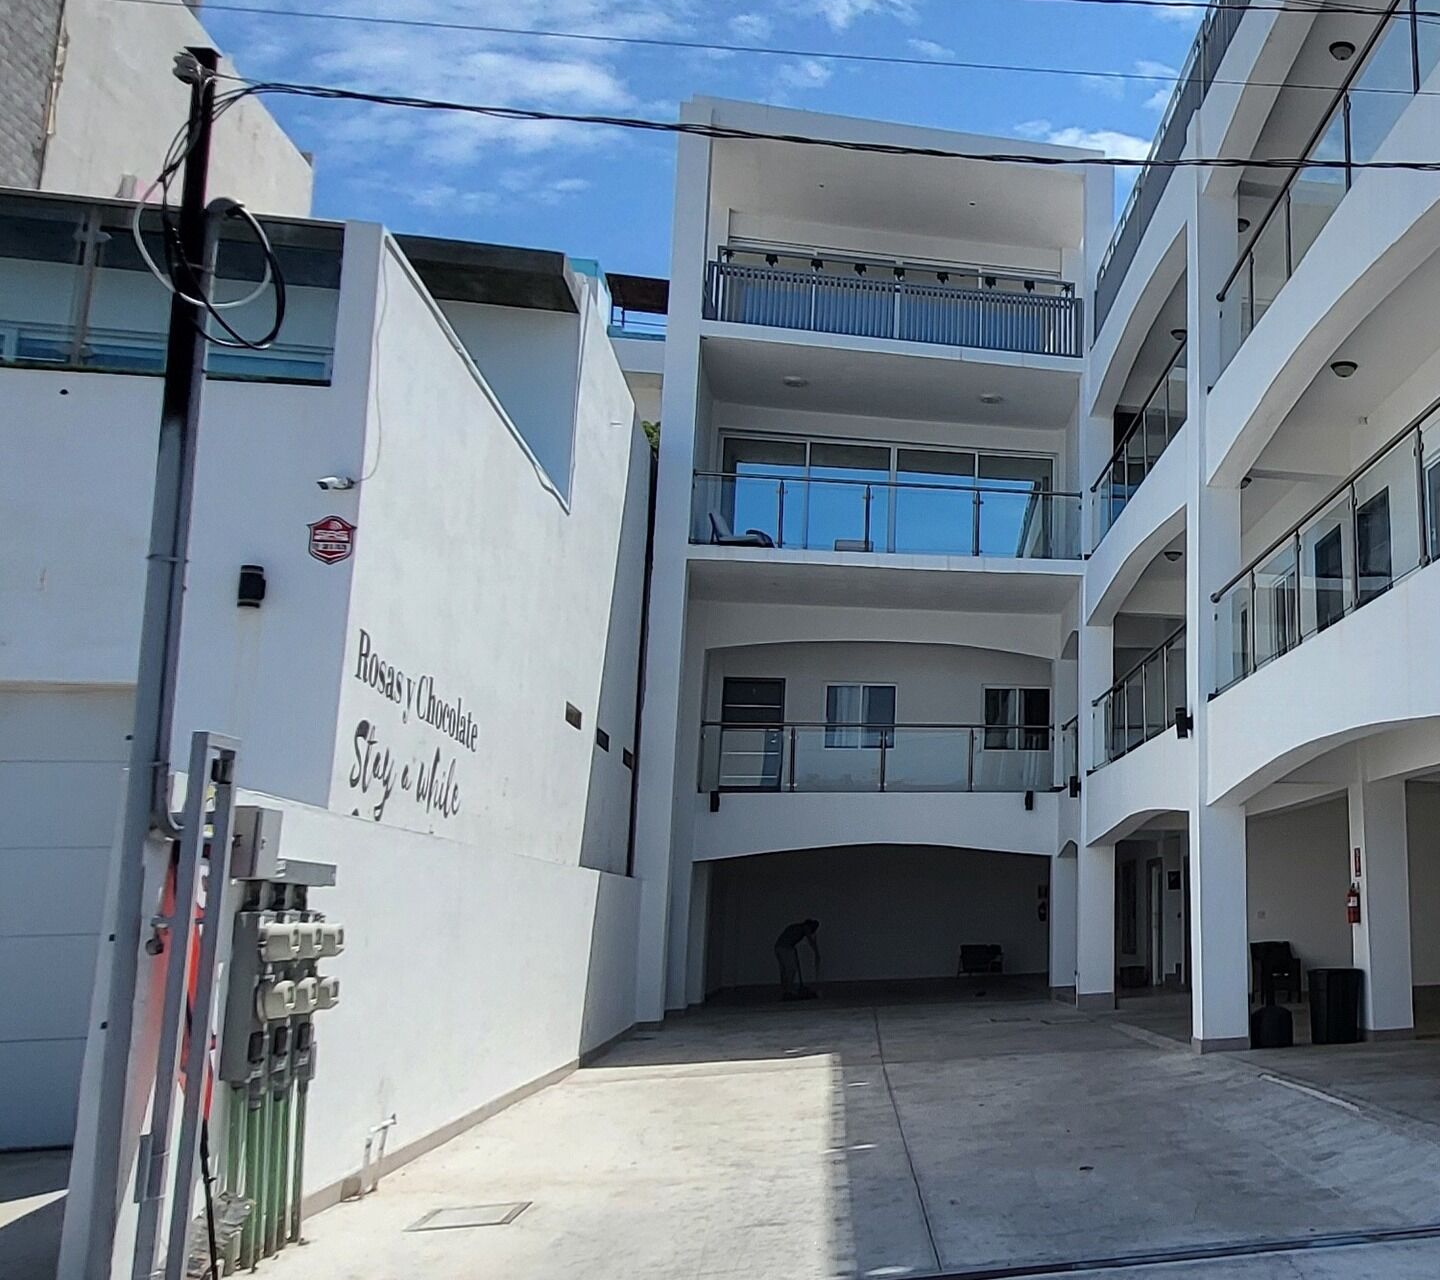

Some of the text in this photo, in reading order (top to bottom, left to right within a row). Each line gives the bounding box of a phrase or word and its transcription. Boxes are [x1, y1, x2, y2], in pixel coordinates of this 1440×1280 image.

[355, 628, 478, 752] Rosas y Chocolate
[350, 720, 396, 821] Stay
[401, 764, 412, 791] a
